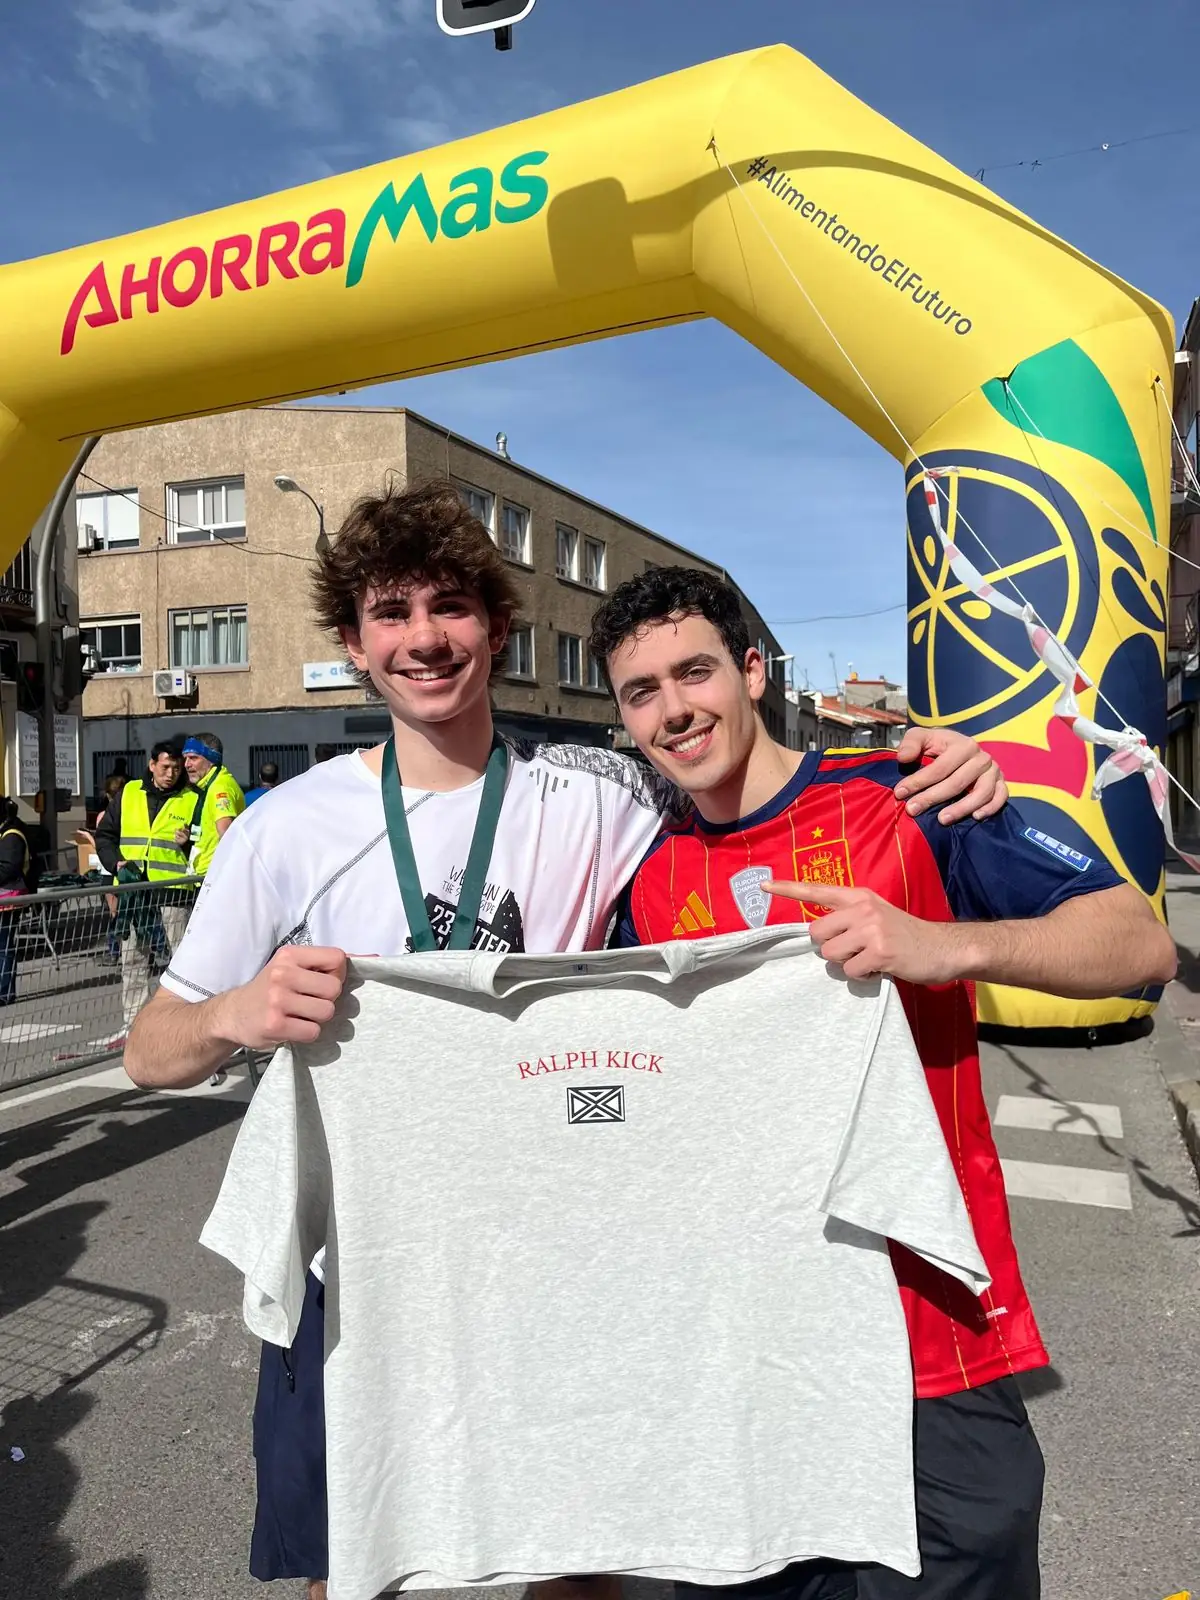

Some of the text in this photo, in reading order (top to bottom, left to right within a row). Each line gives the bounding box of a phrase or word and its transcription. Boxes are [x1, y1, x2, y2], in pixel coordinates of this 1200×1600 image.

[747, 156, 972, 335] #AlimentandoElFuturo
[482, 882, 500, 901] UN
[735, 874, 768, 888] EUROPEAN
[431, 904, 456, 936] 23
[748, 909, 764, 919] 2024
[516, 1050, 664, 1080] RALPH KICK
